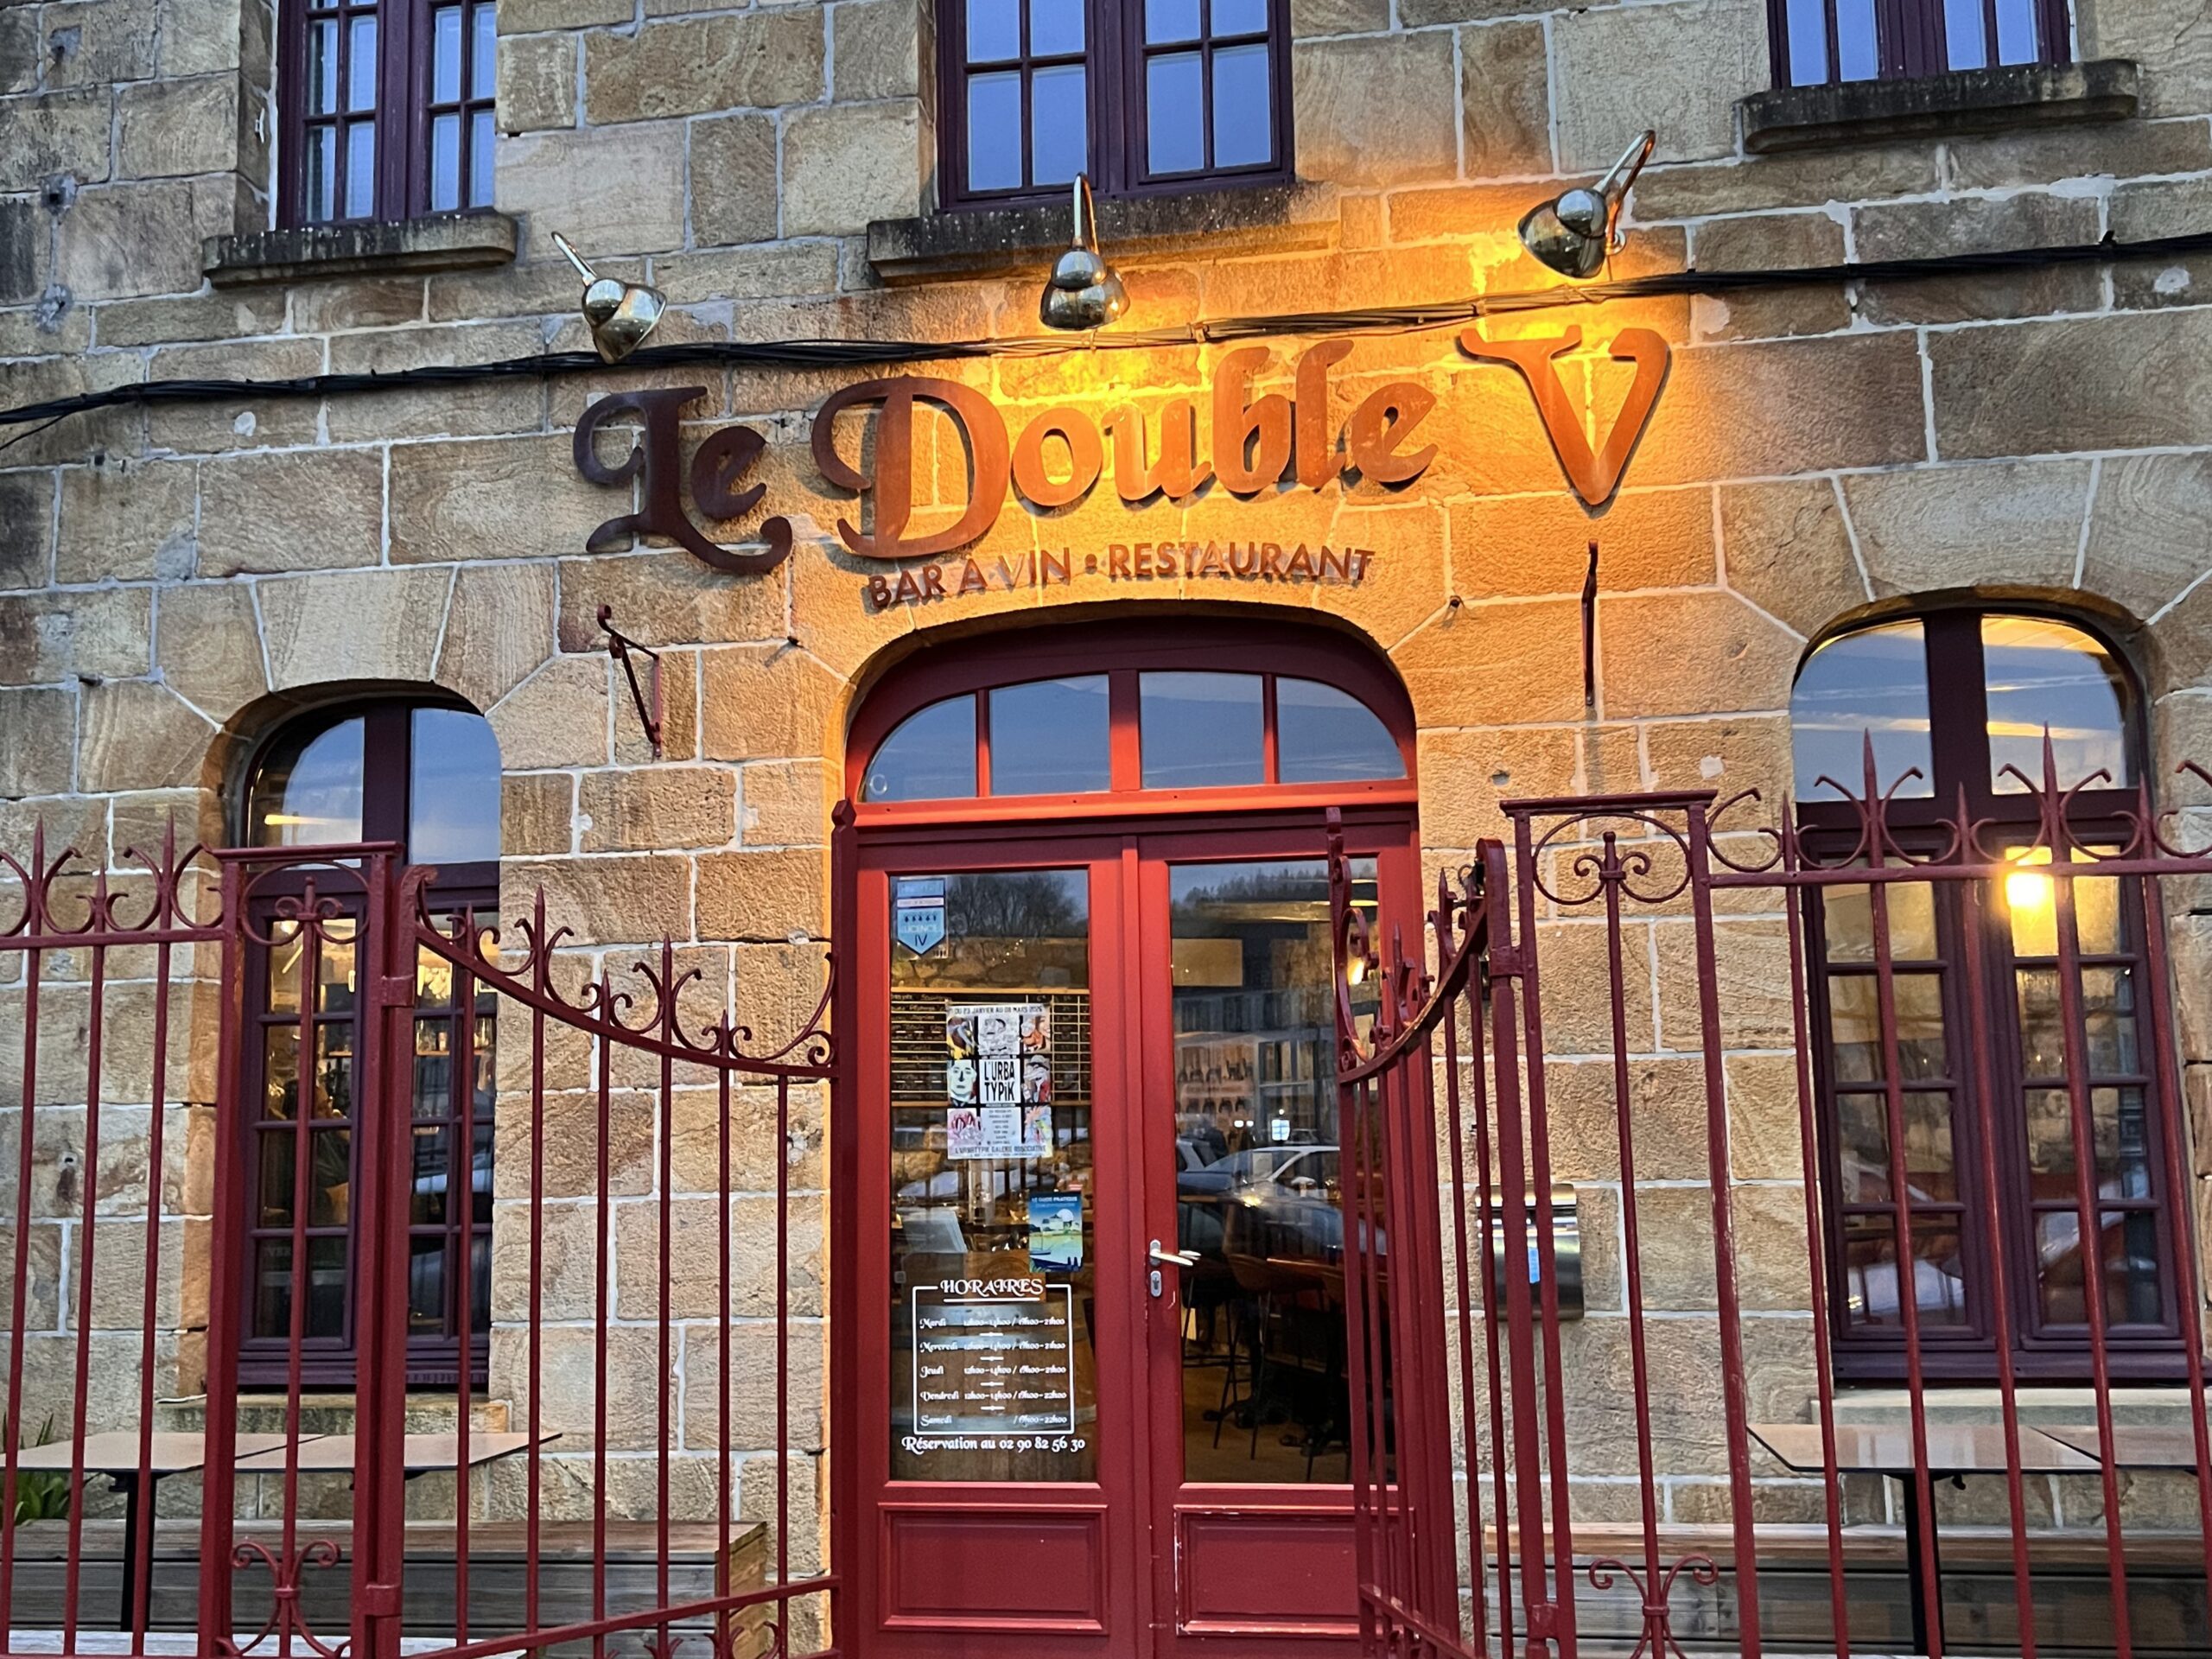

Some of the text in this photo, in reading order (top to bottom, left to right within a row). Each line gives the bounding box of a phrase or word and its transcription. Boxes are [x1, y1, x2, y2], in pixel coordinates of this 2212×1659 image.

[574, 326, 1669, 575] Le Double V
[868, 564, 946, 607] BAR
[998, 547, 1071, 587] VIN
[1109, 540, 1376, 580] RESTAURANT
[915, 934, 927, 947] IV
[984, 1061, 1015, 1080] L'URBA
[940, 1278, 1044, 1297] HORAIRES
[919, 1318, 946, 1329] Mardi
[919, 1343, 958, 1353] Mercredi
[919, 1366, 944, 1378] Jeudi
[919, 1391, 959, 1402] Vendredi
[920, 1415, 952, 1427] Samedi
[901, 1434, 1085, 1455] Réservation au 02 90 82 56 30
